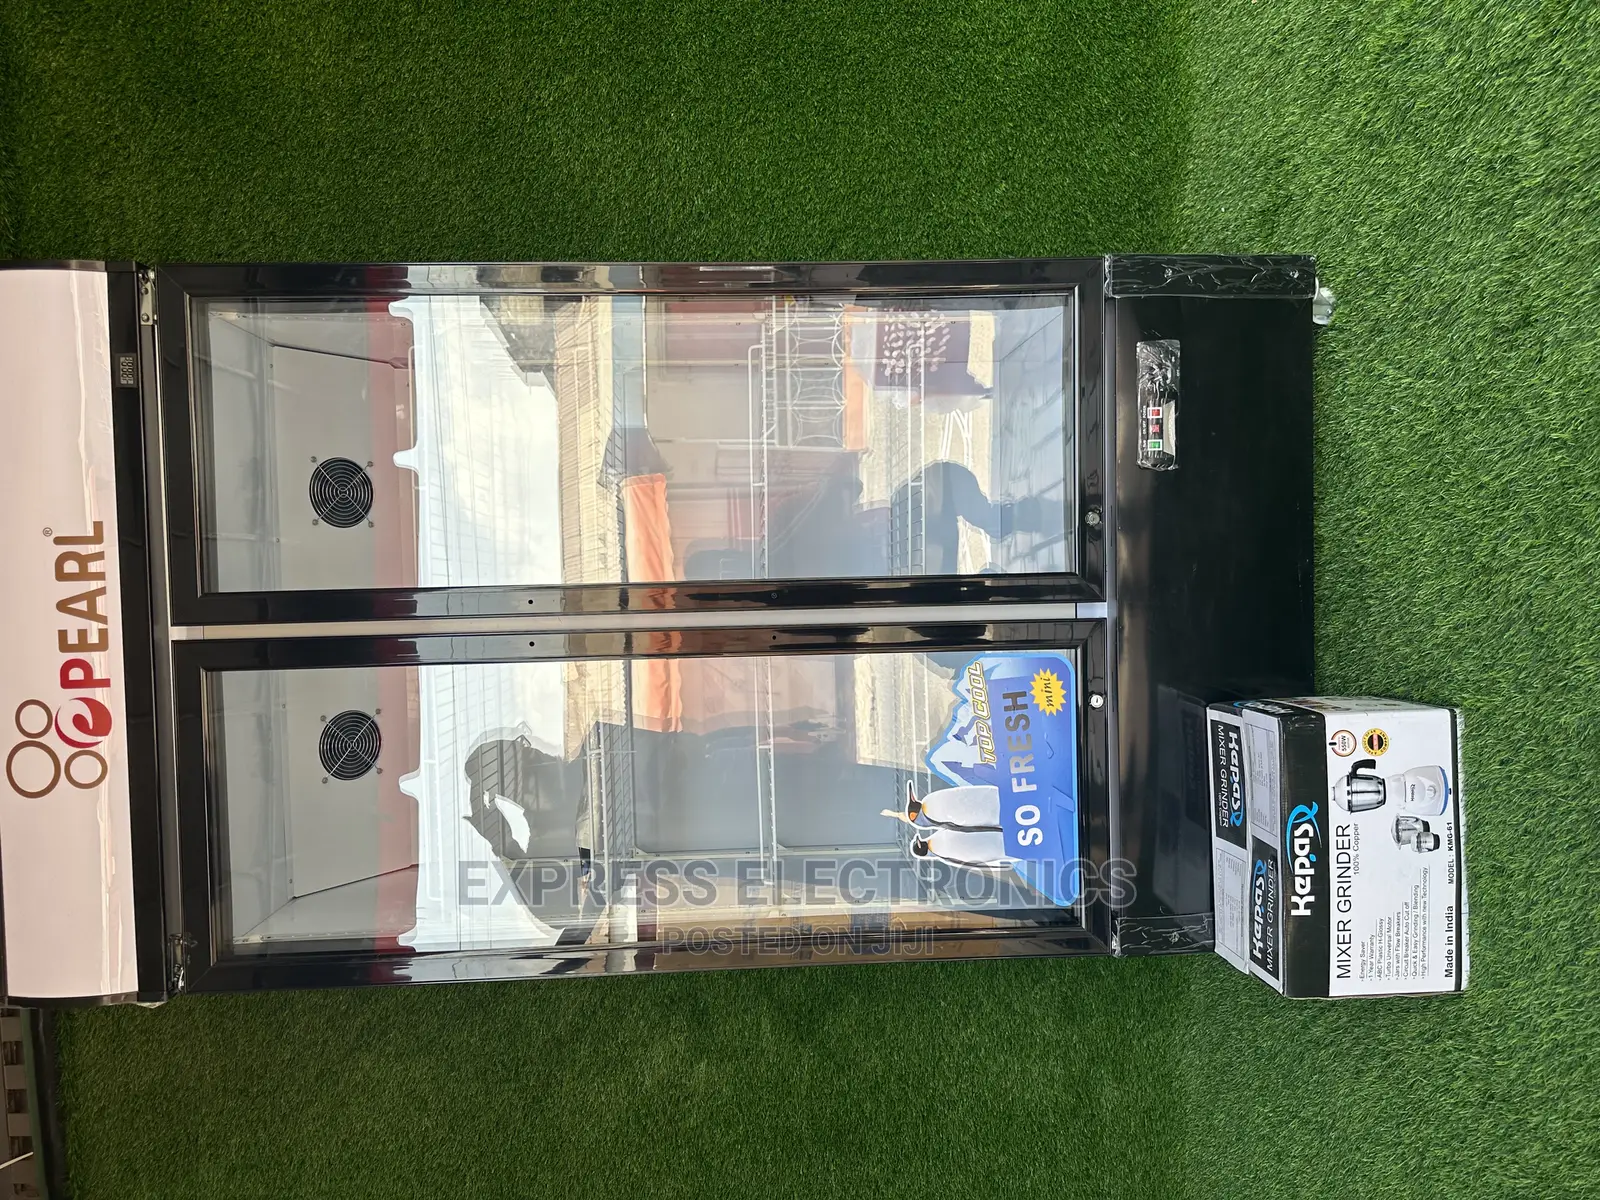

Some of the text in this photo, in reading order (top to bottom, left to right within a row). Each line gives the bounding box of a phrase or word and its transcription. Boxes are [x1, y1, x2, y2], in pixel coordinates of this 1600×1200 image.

[52, 521, 111, 689] PEARL
[967, 661, 996, 763] TOP COOL
[1040, 676, 1055, 708] mini
[1002, 691, 1043, 846] SO FRESH
[1218, 725, 1229, 827] MIXER GRINDER
[1228, 732, 1241, 810] Kepas
[1252, 876, 1264, 959] Kepas
[1290, 823, 1316, 916] Kepas
[1335, 824, 1352, 979] MIXER GRINDER
[1444, 906, 1454, 978] Made in India
